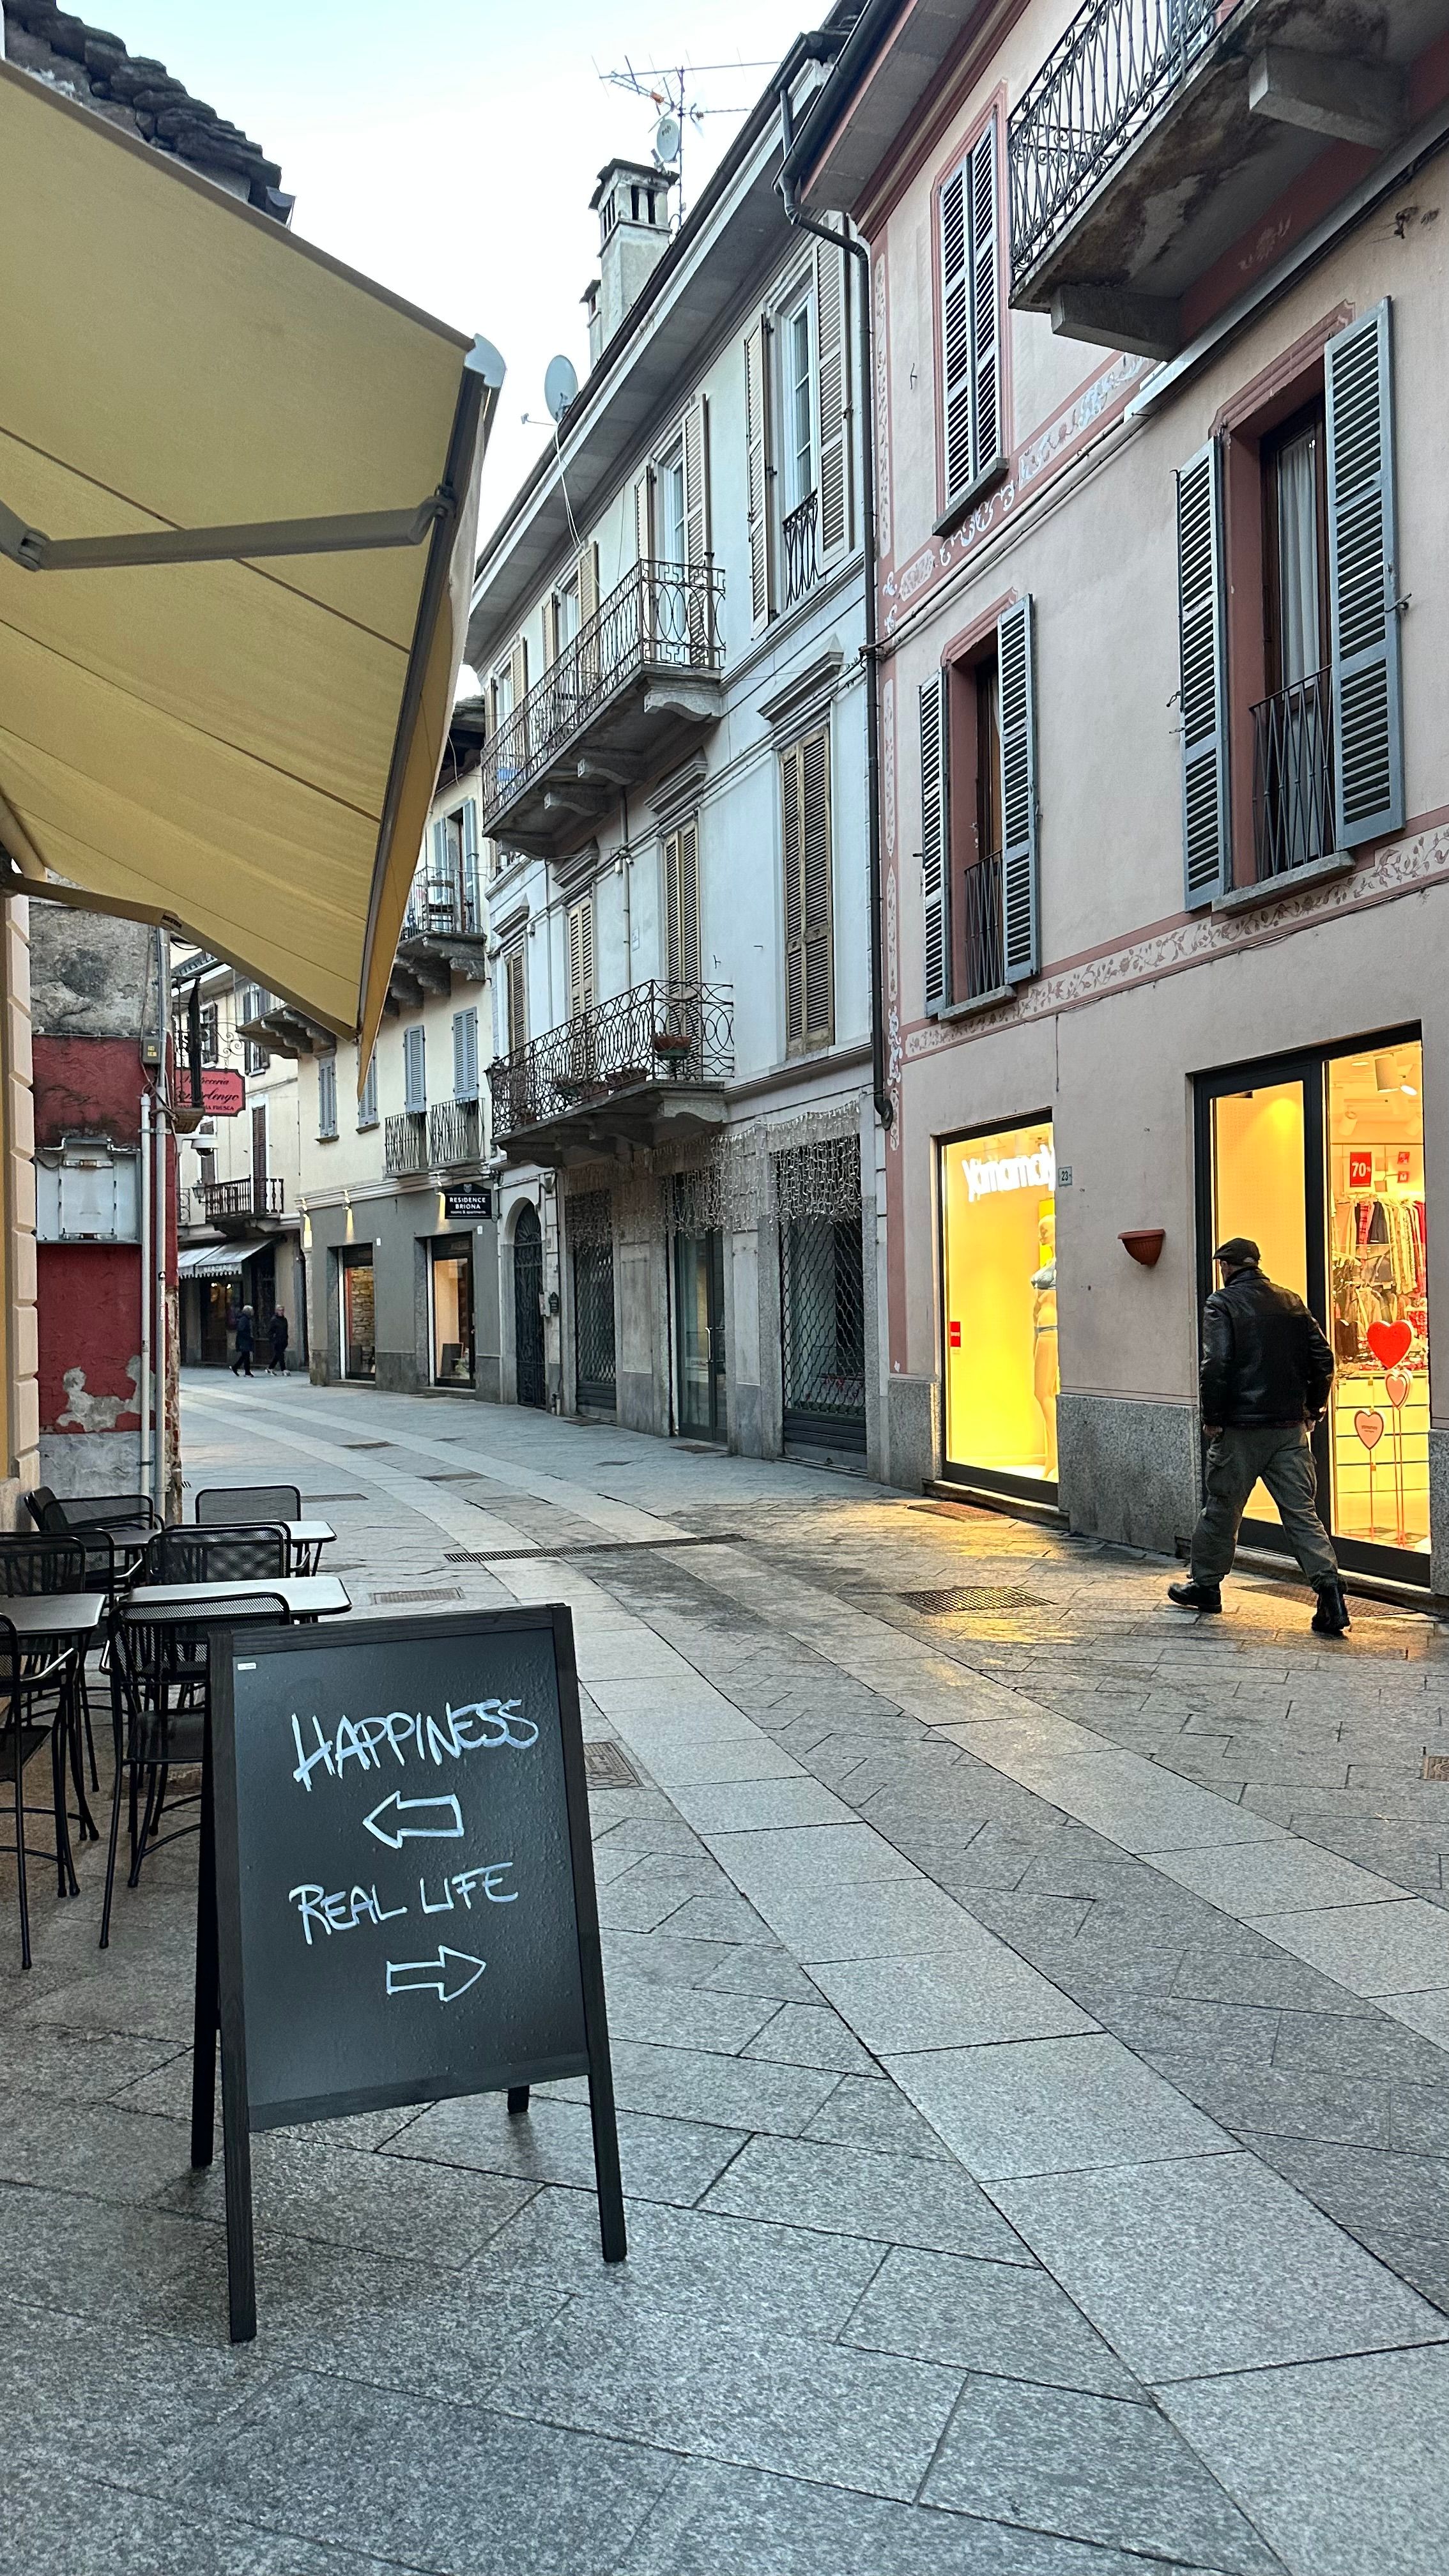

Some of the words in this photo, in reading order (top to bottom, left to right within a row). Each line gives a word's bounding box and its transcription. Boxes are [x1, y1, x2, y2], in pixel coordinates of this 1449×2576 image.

[1061, 1170, 1068, 1181] 23
[291, 1698, 539, 1791] HAPPINESS
[288, 1883, 408, 1945] REAL
[420, 1862, 519, 1914] LIFE
